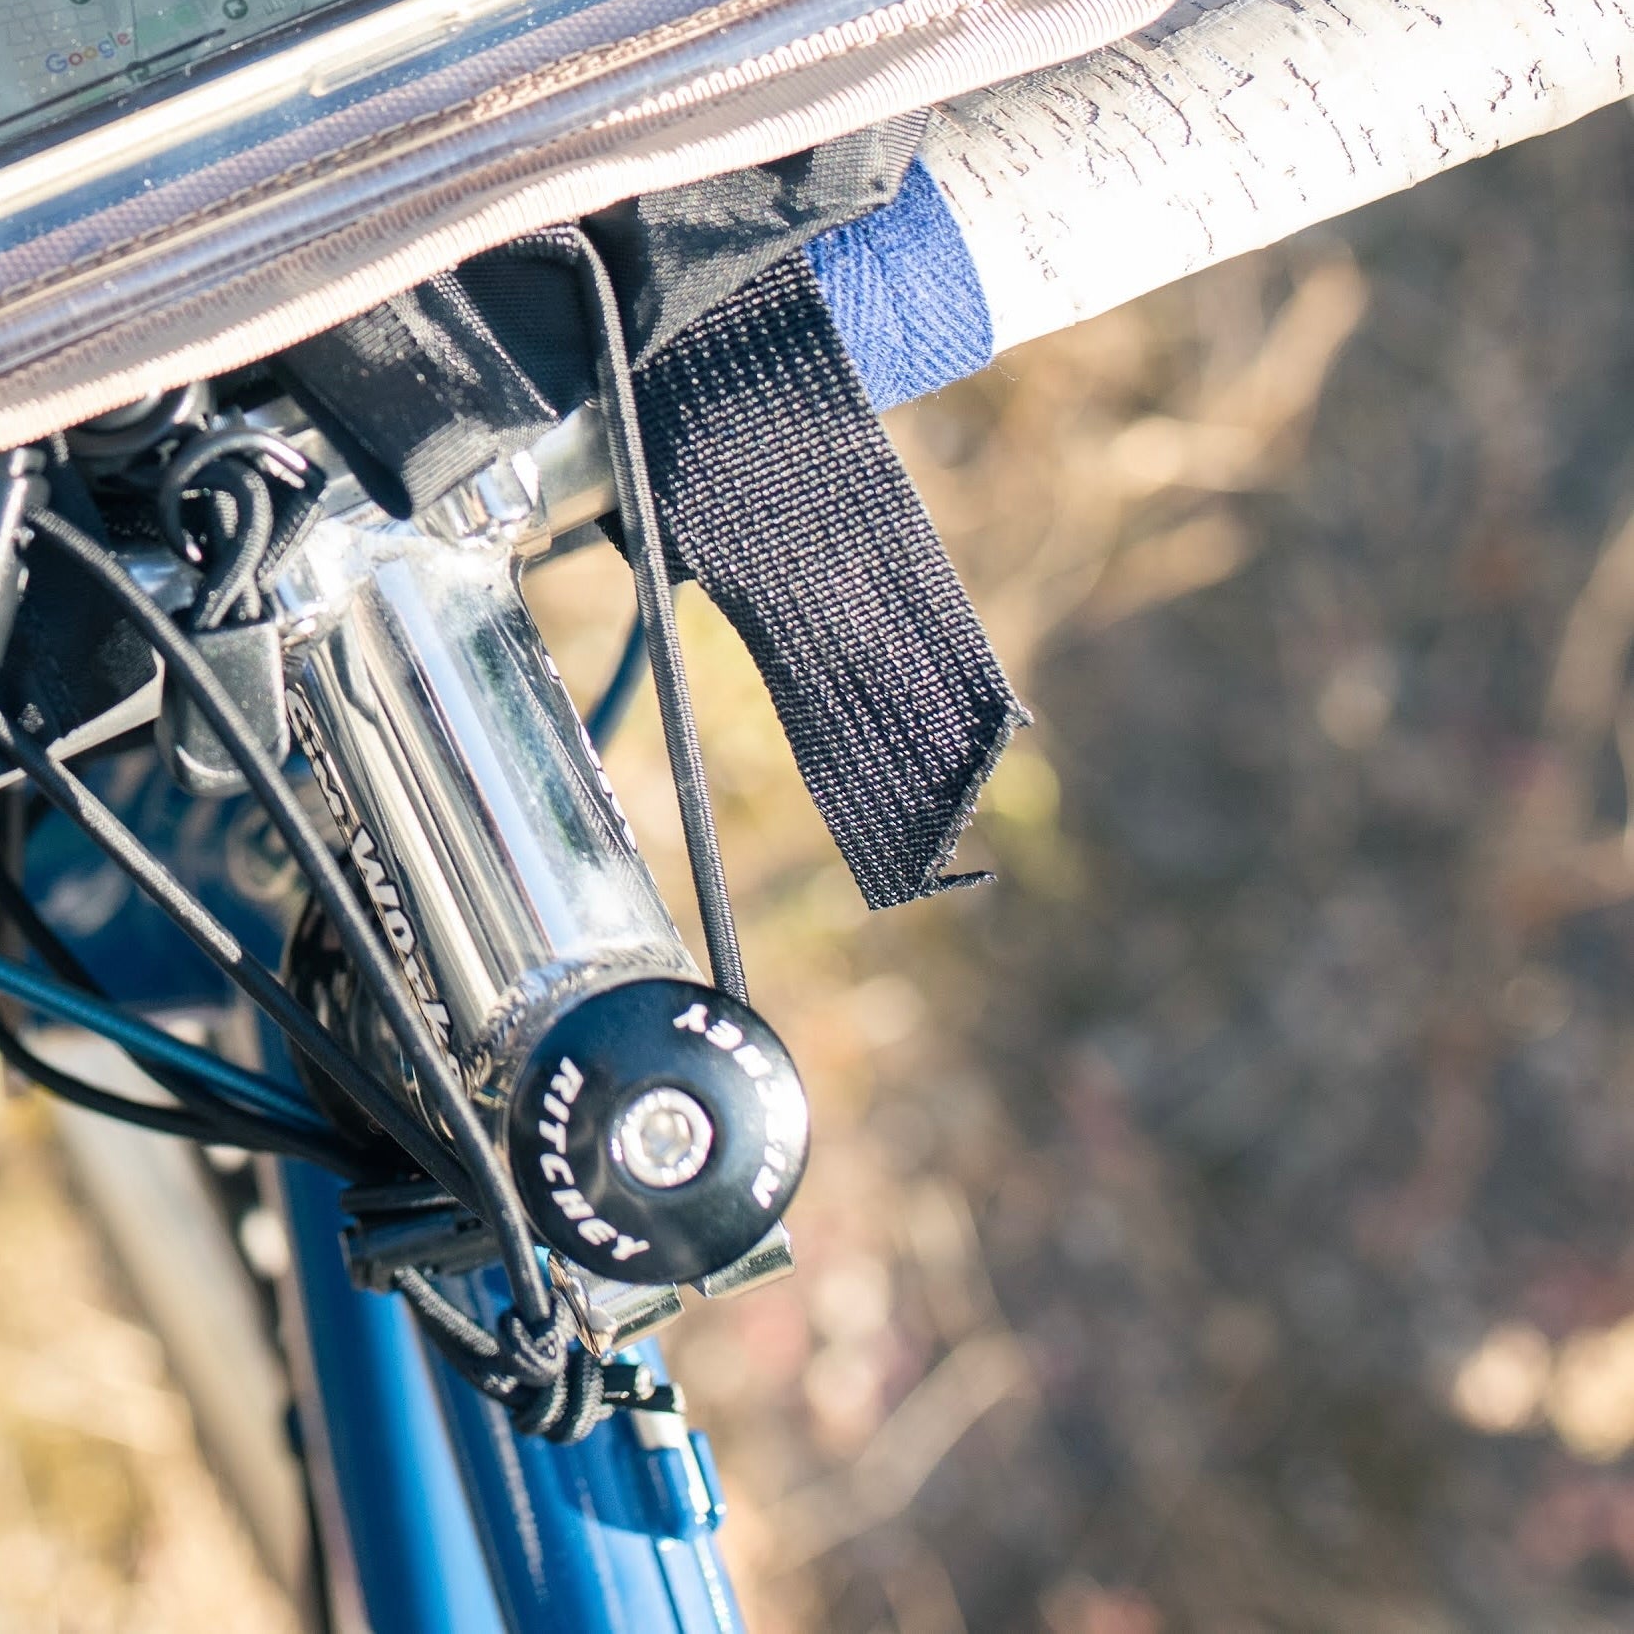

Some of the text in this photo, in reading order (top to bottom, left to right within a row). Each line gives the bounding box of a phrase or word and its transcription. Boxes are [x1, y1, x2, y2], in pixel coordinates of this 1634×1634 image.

[41, 24, 135, 82] Google
[539, 1056, 651, 1261] RITCHEY
[673, 1003, 788, 1209] RIHEY
